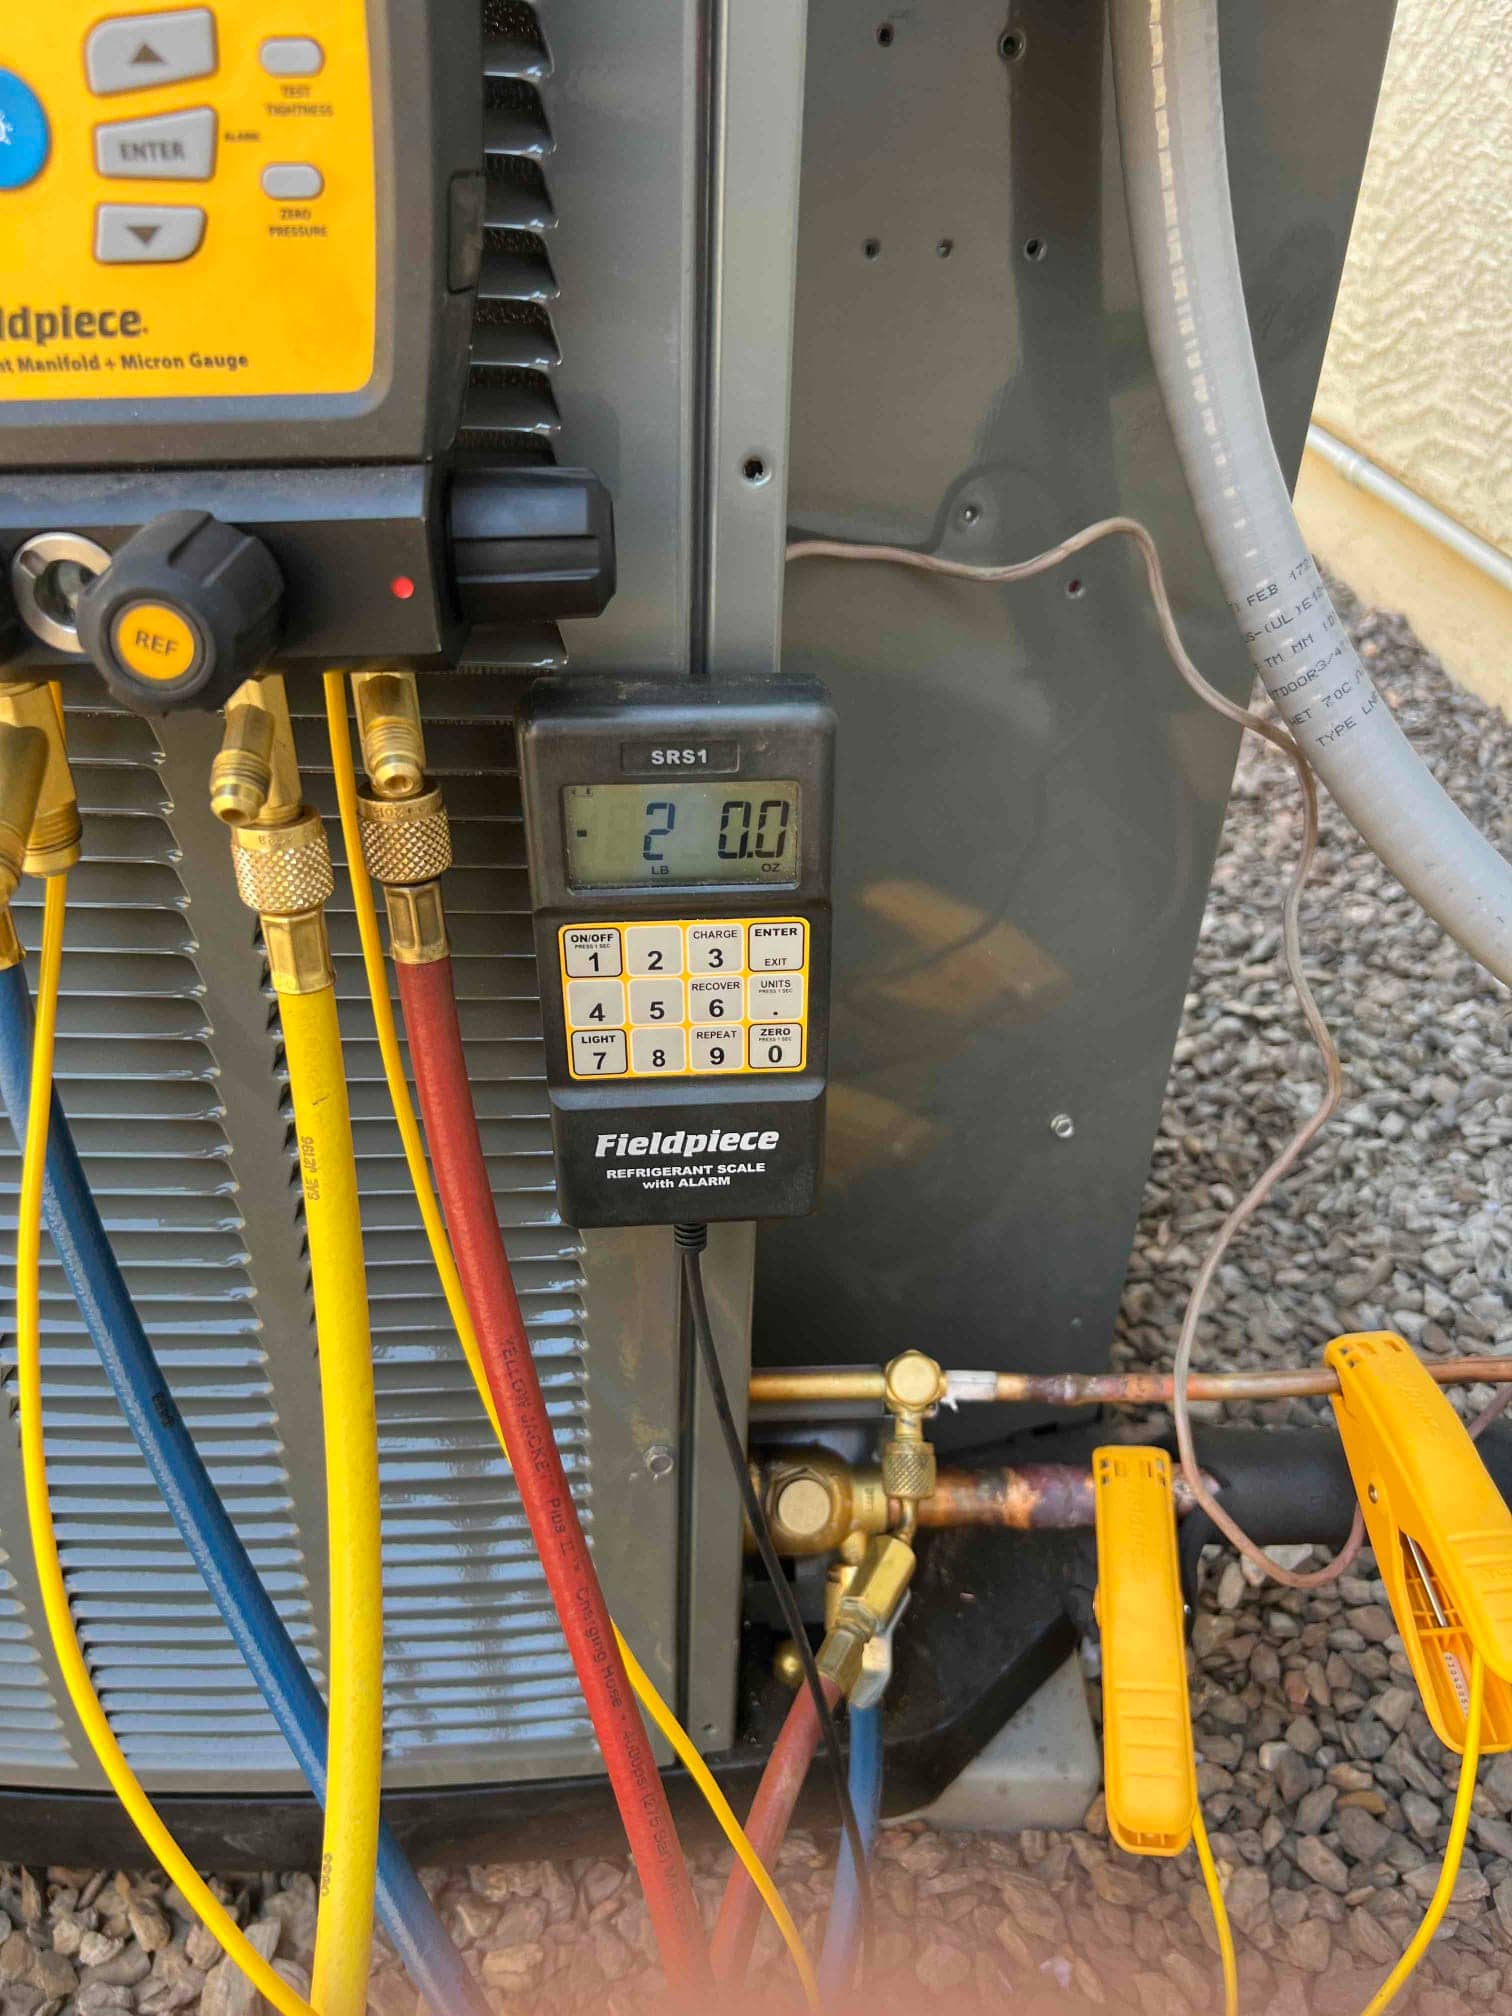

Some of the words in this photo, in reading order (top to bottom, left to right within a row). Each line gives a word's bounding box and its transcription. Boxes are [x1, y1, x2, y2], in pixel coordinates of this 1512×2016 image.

[120, 141, 186, 162] ENTER
[281, 209, 311, 220] ZERO
[269, 226, 328, 238] PRESSURE
[18, 354, 100, 373] Manifold
[121, 352, 184, 371] Micron
[190, 351, 249, 372] Gauge
[1246, 583, 1279, 607] FEB
[135, 630, 179, 656] REF
[1315, 716, 1358, 747] TYPE
[651, 749, 708, 765] SRS1
[643, 802, 676, 861] 2
[717, 800, 790, 860] 0.0
[651, 865, 669, 875] LB
[761, 863, 781, 873] OZ
[570, 933, 614, 943] ON/OFF
[693, 929, 738, 939] CHARGE
[755, 928, 798, 937] ENTER
[588, 952, 600, 971] 1
[648, 951, 663, 970] 2
[708, 949, 724, 968] 3
[764, 958, 787, 967] EXIT
[691, 981, 740, 991] RECOVER
[761, 980, 791, 988] UNITS
[589, 1003, 605, 1021] 4
[650, 1001, 665, 1019] 5
[709, 999, 724, 1017] 6
[581, 1035, 616, 1044] LIGHT
[696, 1030, 737, 1040] REPEAT
[761, 1028, 791, 1036] ZERO
[593, 1052, 607, 1070] 7
[652, 1050, 666, 1067] 8
[710, 1047, 725, 1065] 9
[768, 1045, 783, 1063] 0
[595, 1129, 780, 1157] Fieldpiece
[606, 1165, 714, 1179] REFRIGERANT
[717, 1163, 766, 1174] SCALE
[643, 1178, 675, 1189] with
[678, 1176, 731, 1187] ALARM
